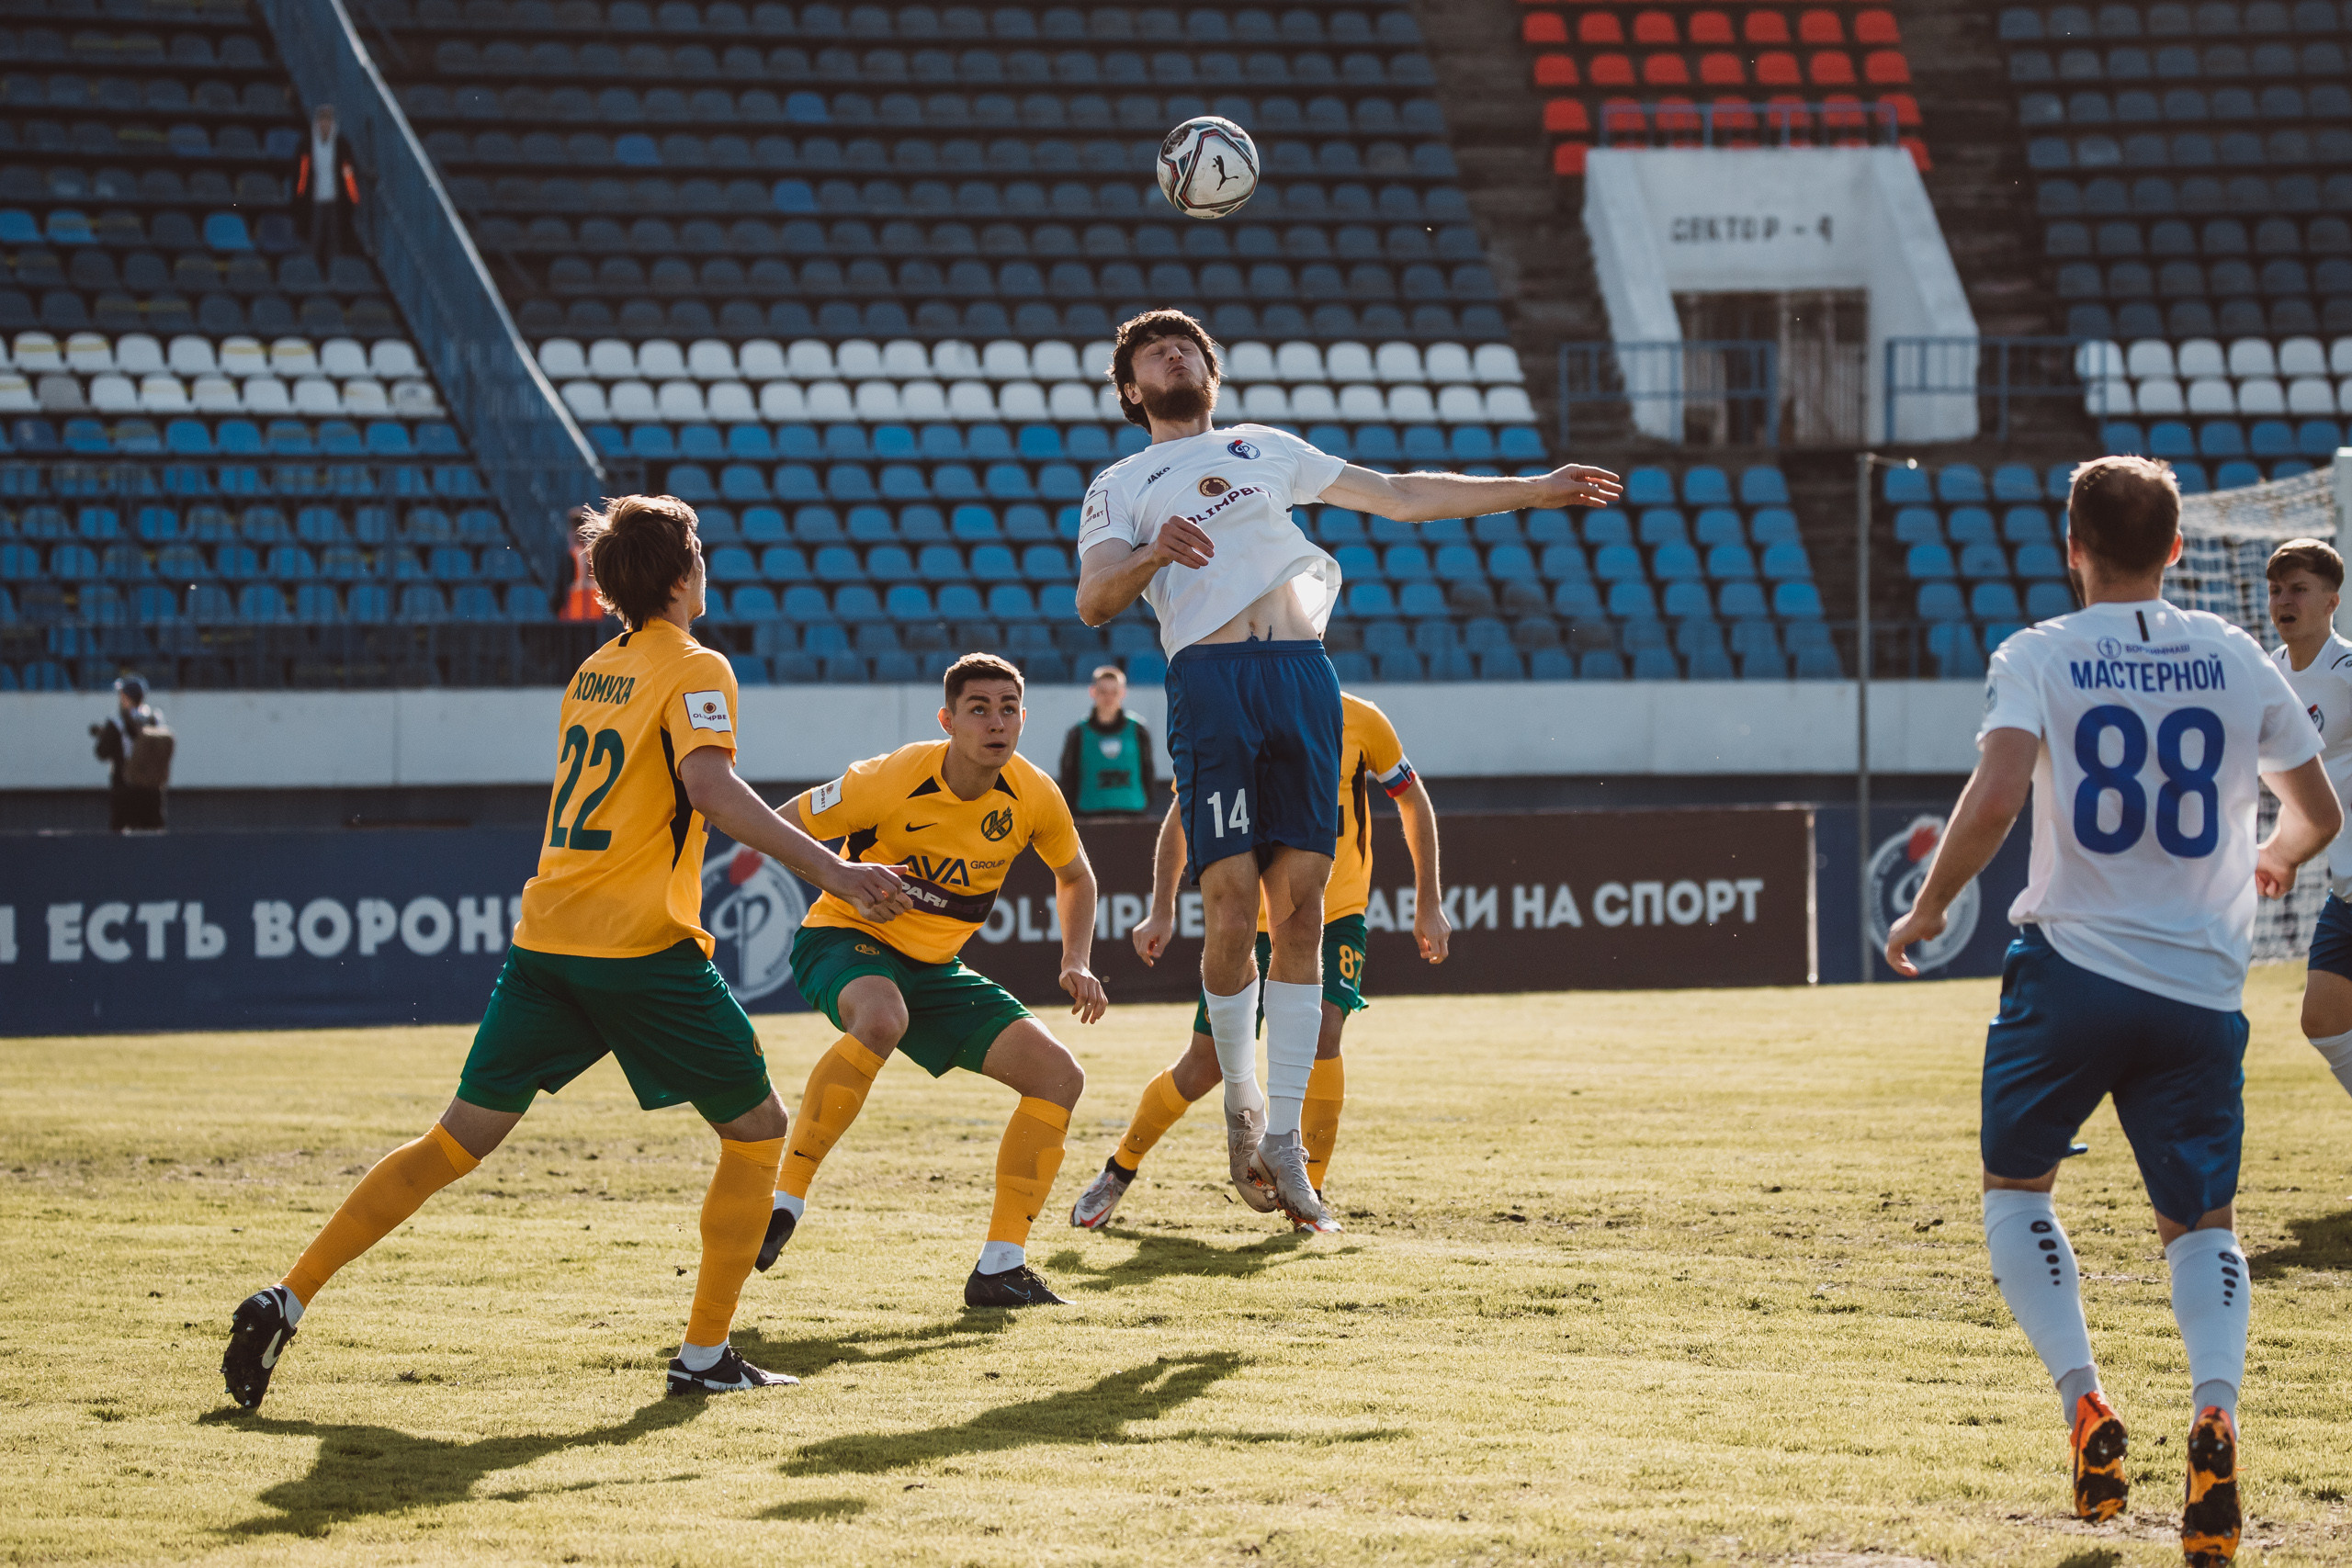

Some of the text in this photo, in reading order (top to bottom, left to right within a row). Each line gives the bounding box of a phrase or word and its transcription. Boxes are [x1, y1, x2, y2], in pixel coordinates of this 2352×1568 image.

[1148, 467, 1171, 485] JAKO
[571, 671, 636, 705] ХОМУХА
[2070, 652, 2227, 694] МАСТЕРНОЙ
[548, 724, 625, 851] 22
[2074, 704, 2226, 859] 88
[1206, 787, 1250, 838] 14
[895, 854, 1006, 887] AVA GROUP
[1511, 883, 1584, 930] НА
[1592, 877, 1765, 928] СПОРТ
[46, 900, 227, 963] ЕСТЬ
[252, 895, 523, 958] ВОРОН
[1339, 944, 1363, 987] 87
